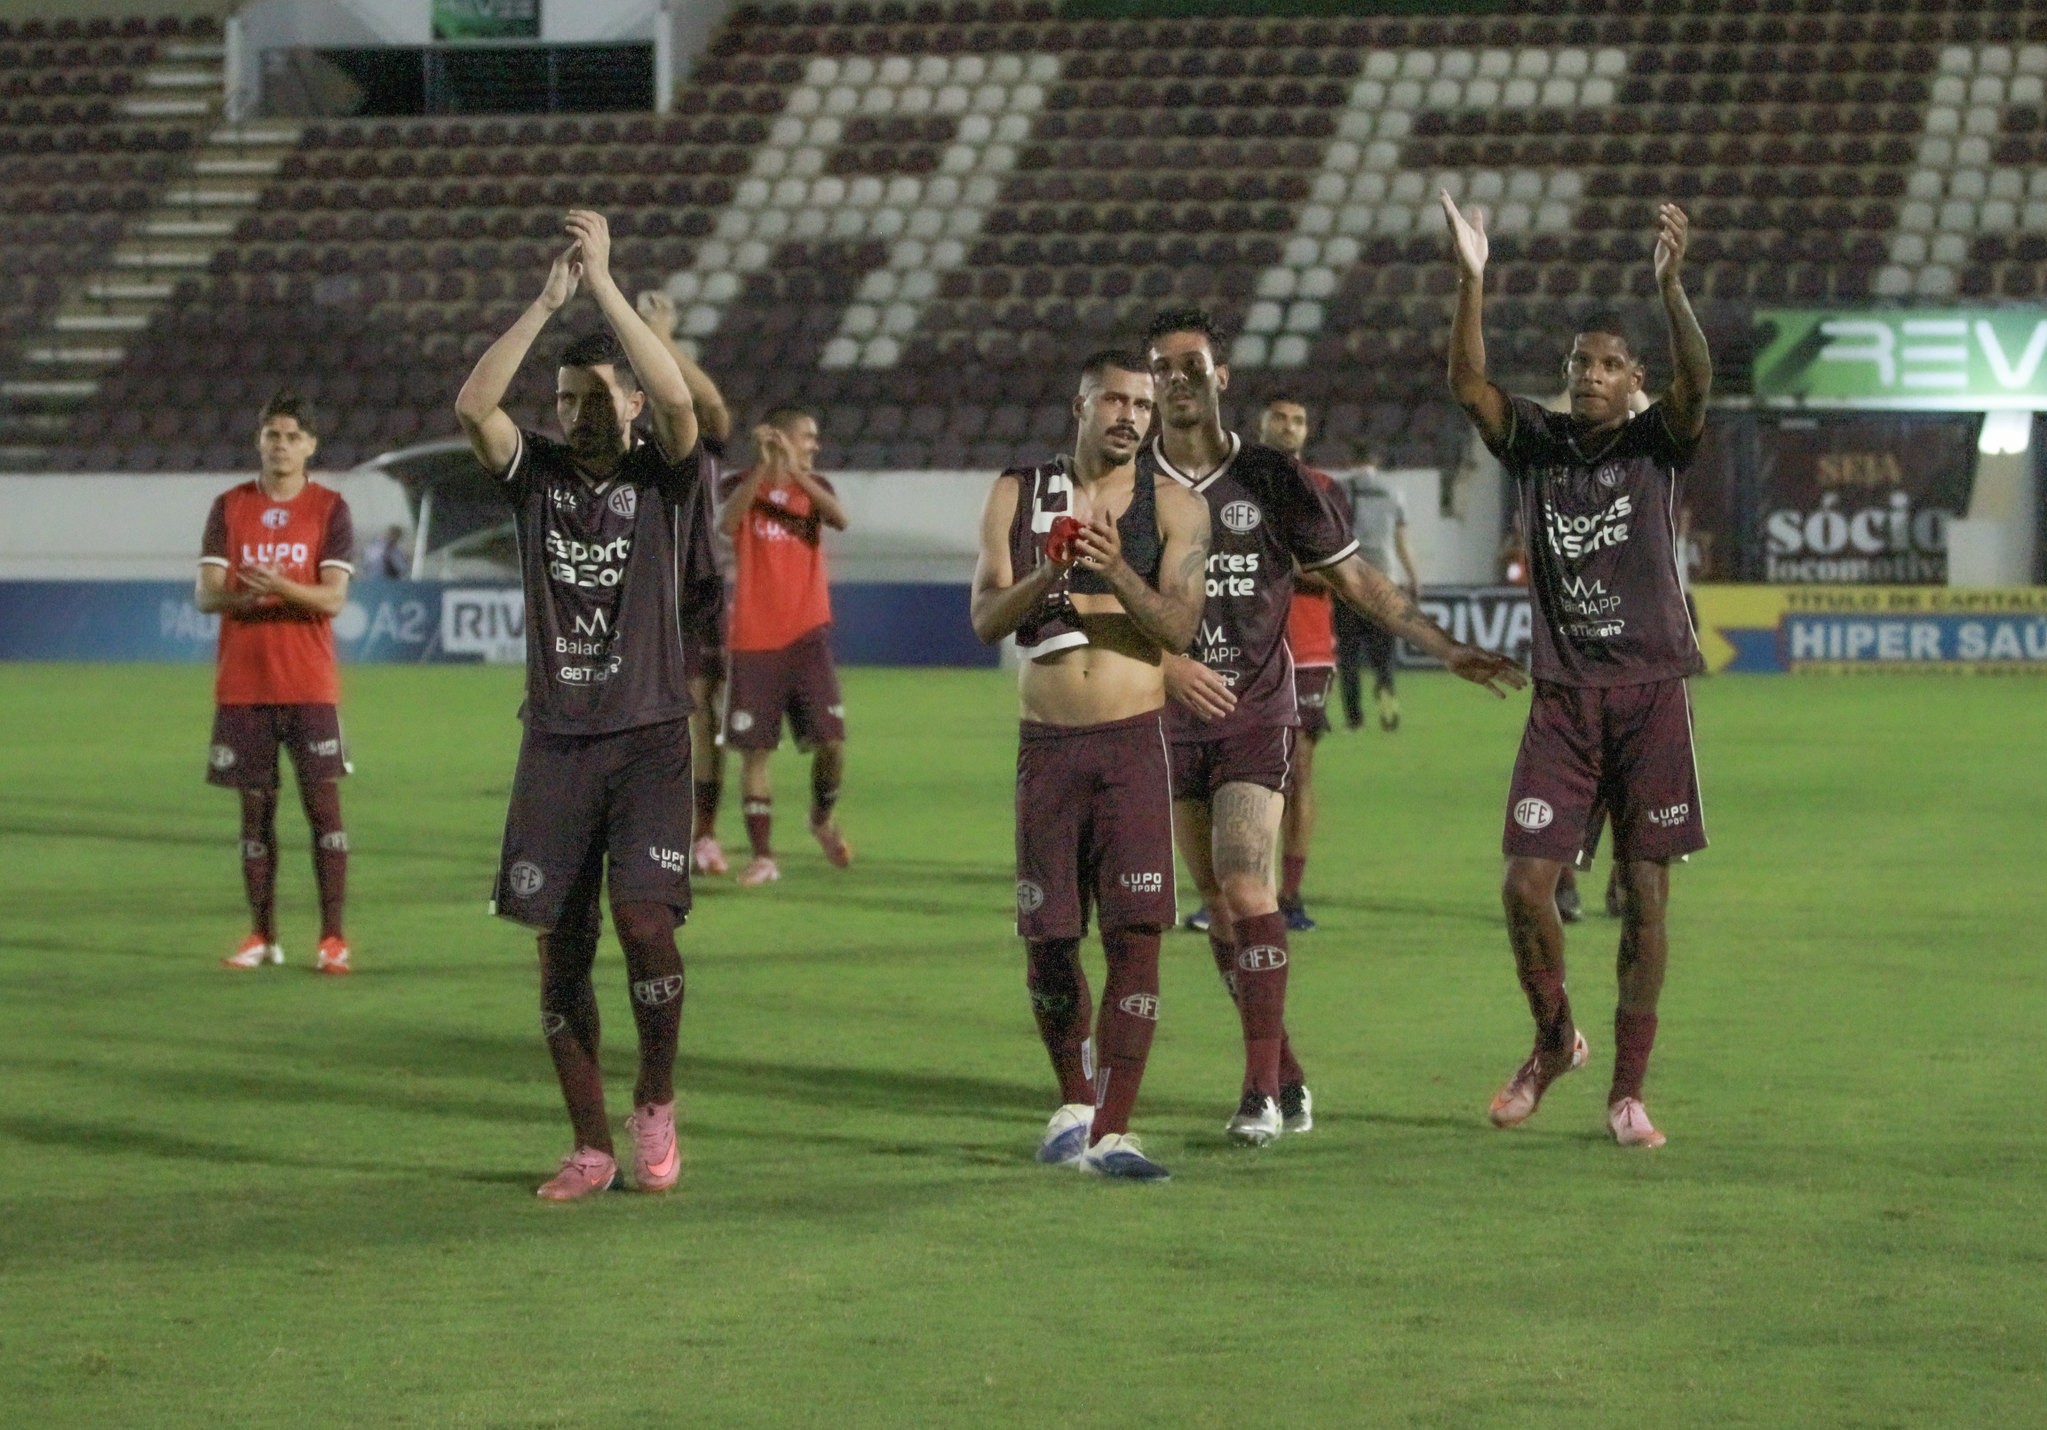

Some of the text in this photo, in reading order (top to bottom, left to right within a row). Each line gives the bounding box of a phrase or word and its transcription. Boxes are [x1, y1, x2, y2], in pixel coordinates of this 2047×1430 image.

[1223, 503, 1257, 527] AFE
[1767, 491, 1947, 553] sócio
[1204, 551, 1259, 573] rtes
[1931, 592, 2047, 609] CAPITAL
[1791, 621, 1943, 660] HIPER
[1517, 802, 1549, 825] AFE
[1649, 803, 1690, 823] LUPO
[1120, 872, 1162, 888] LUPO
[1131, 884, 1162, 893] SPORT
[1241, 949, 1280, 969] AFE
